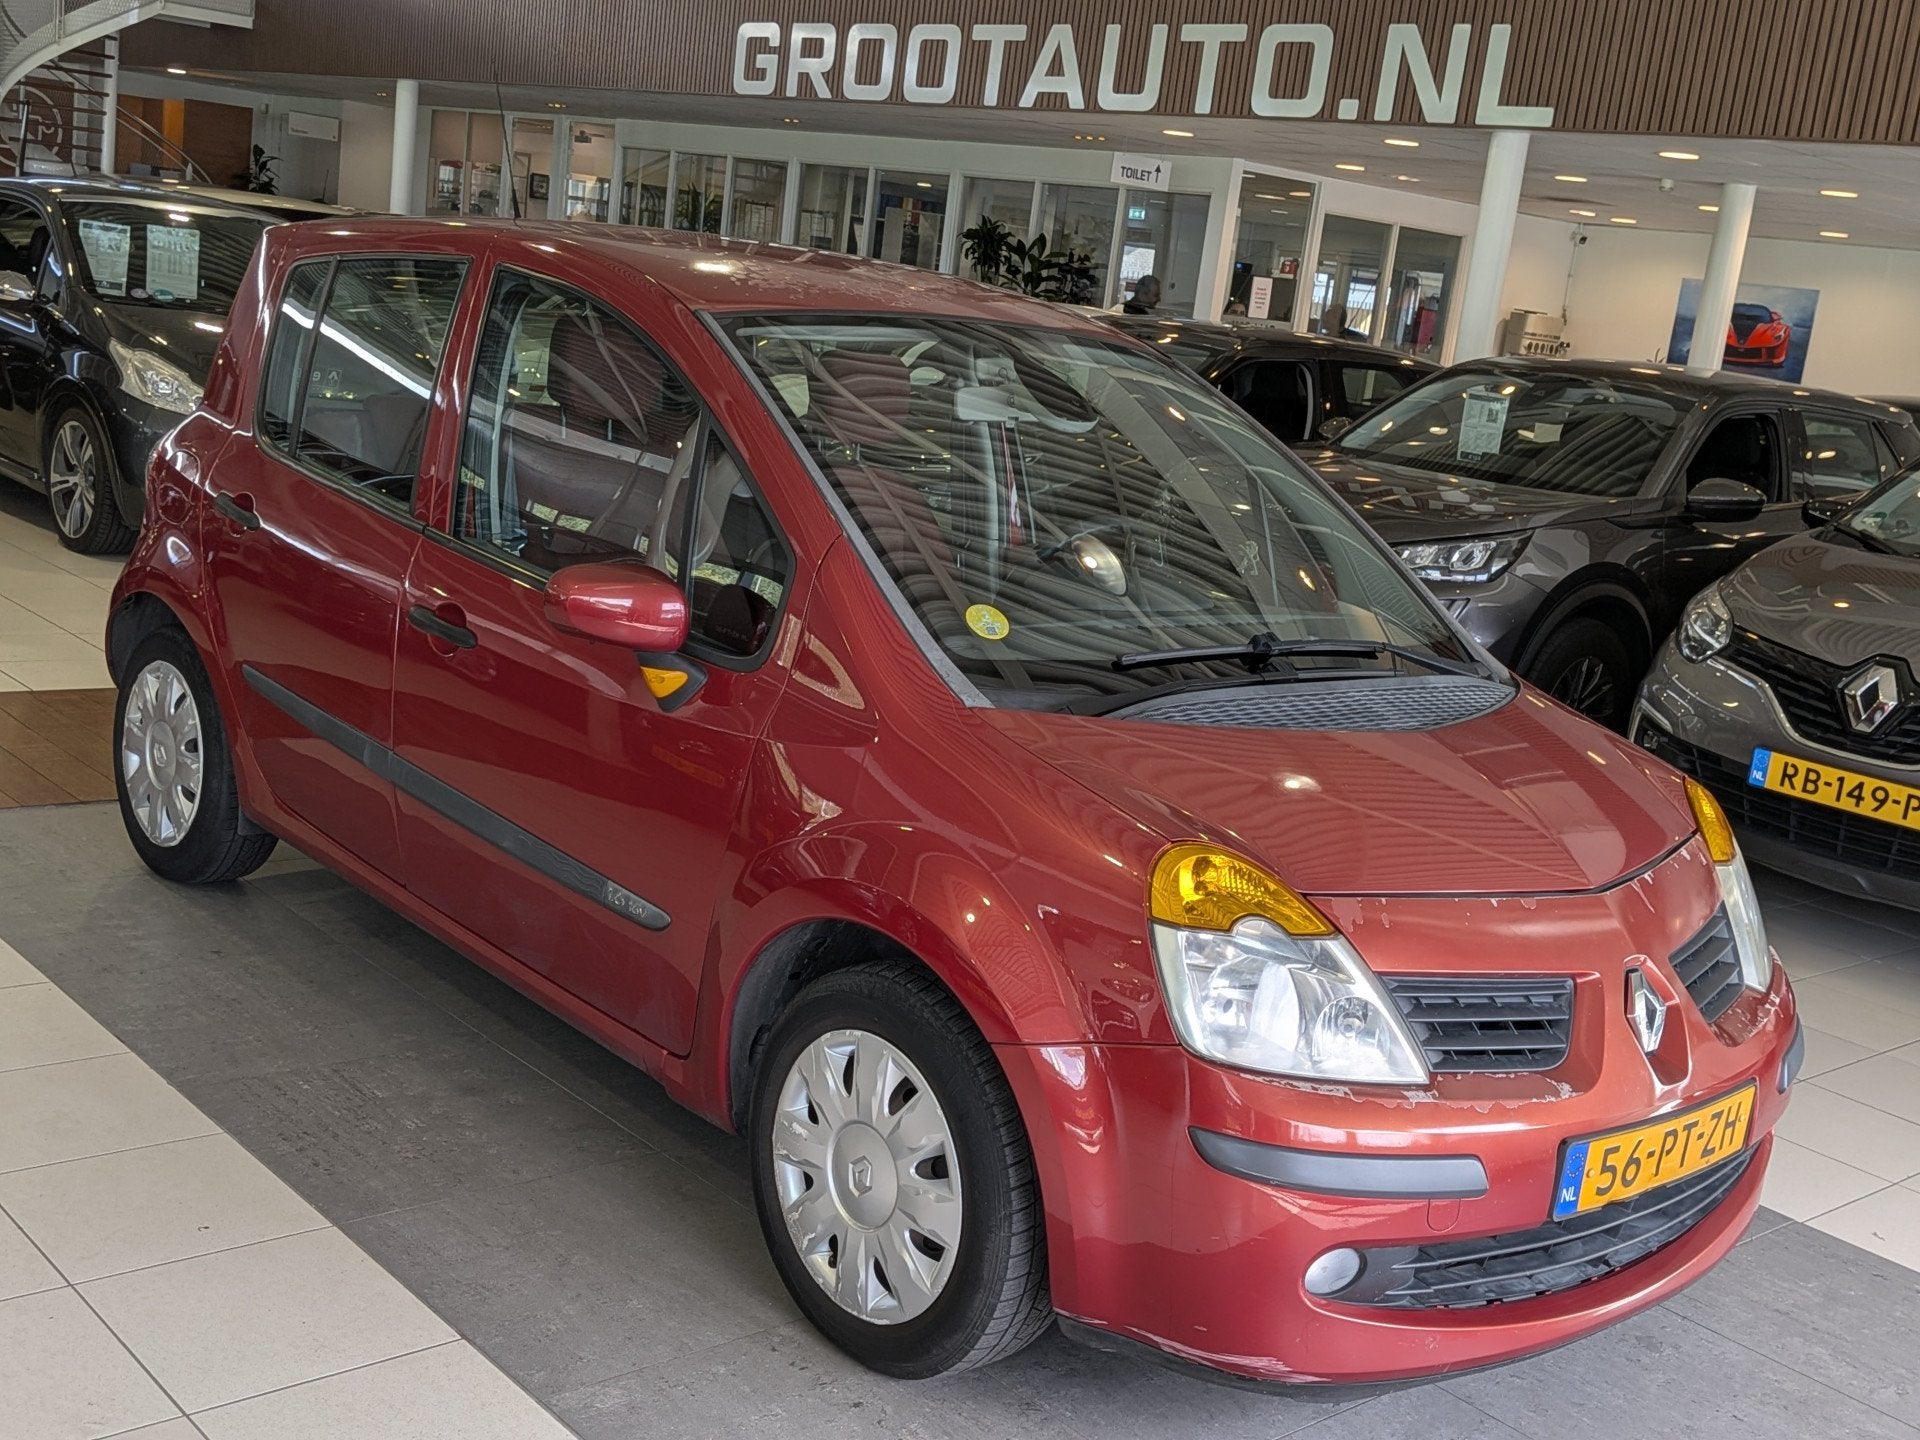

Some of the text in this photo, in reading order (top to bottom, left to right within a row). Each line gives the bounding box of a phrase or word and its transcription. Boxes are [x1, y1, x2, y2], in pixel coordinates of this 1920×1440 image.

[733, 22, 1555, 128] GROOTAUTO.NL
[1120, 165, 1152, 182] TOILET
[1752, 761, 1920, 820] NL RB-149-P
[1560, 1101, 1742, 1204] NL 56-PT-ZH
